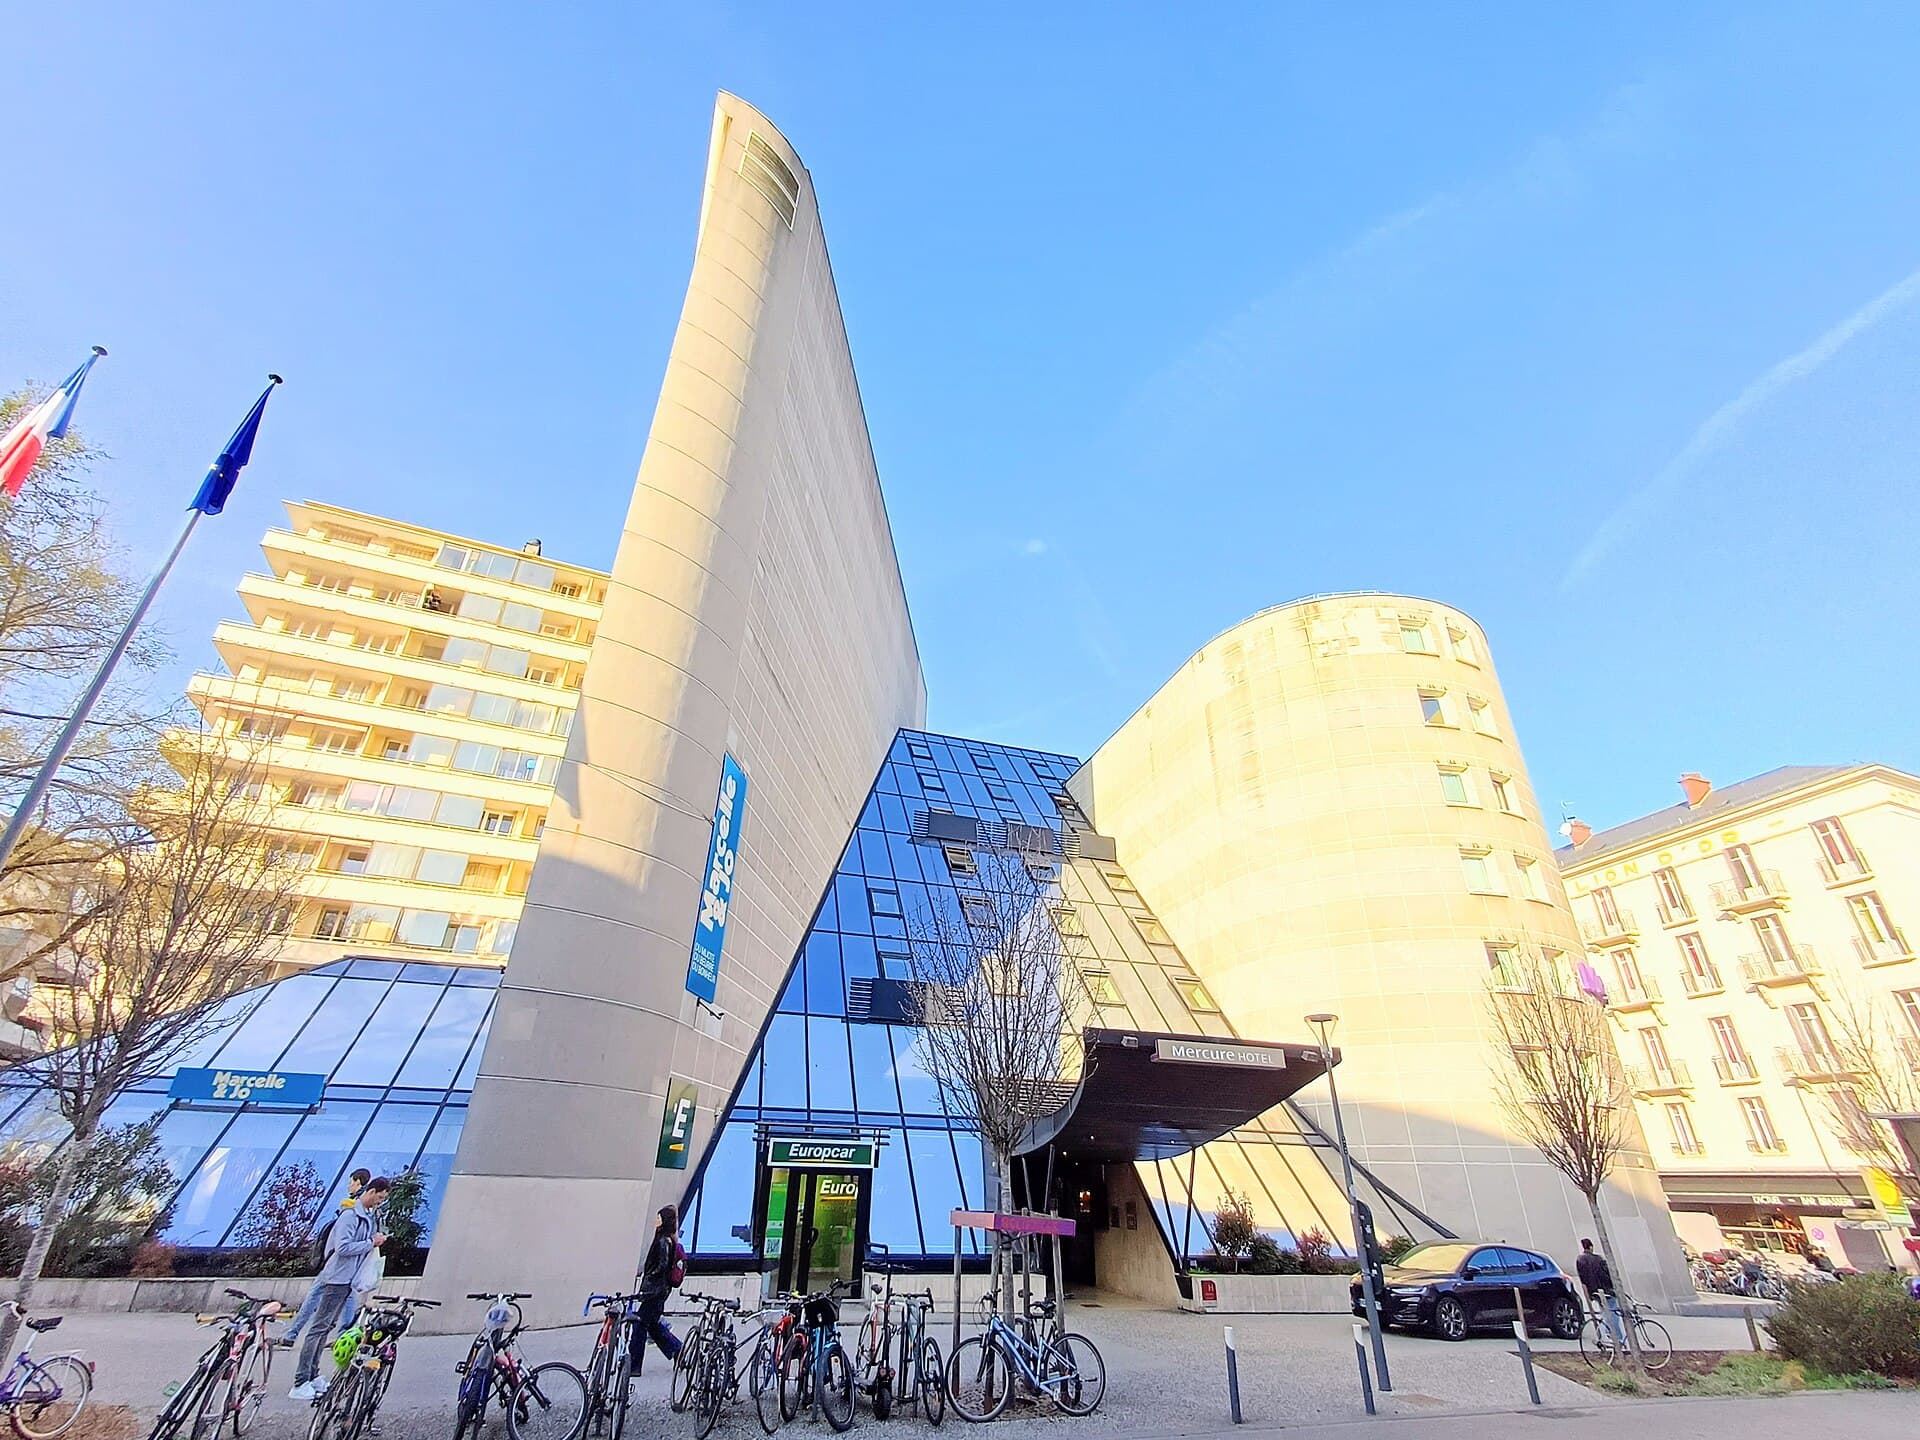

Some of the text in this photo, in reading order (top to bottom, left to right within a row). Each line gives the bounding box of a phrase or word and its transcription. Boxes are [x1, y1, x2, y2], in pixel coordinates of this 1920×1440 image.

[700, 775, 736, 932] Marcelle
[713, 849, 735, 928] & Jo
[1171, 1045, 1273, 1064] Mercure HOTEL
[212, 1071, 286, 1089] Marcelle
[213, 1084, 250, 1099] & Jo
[789, 1143, 856, 1162] Europcar
